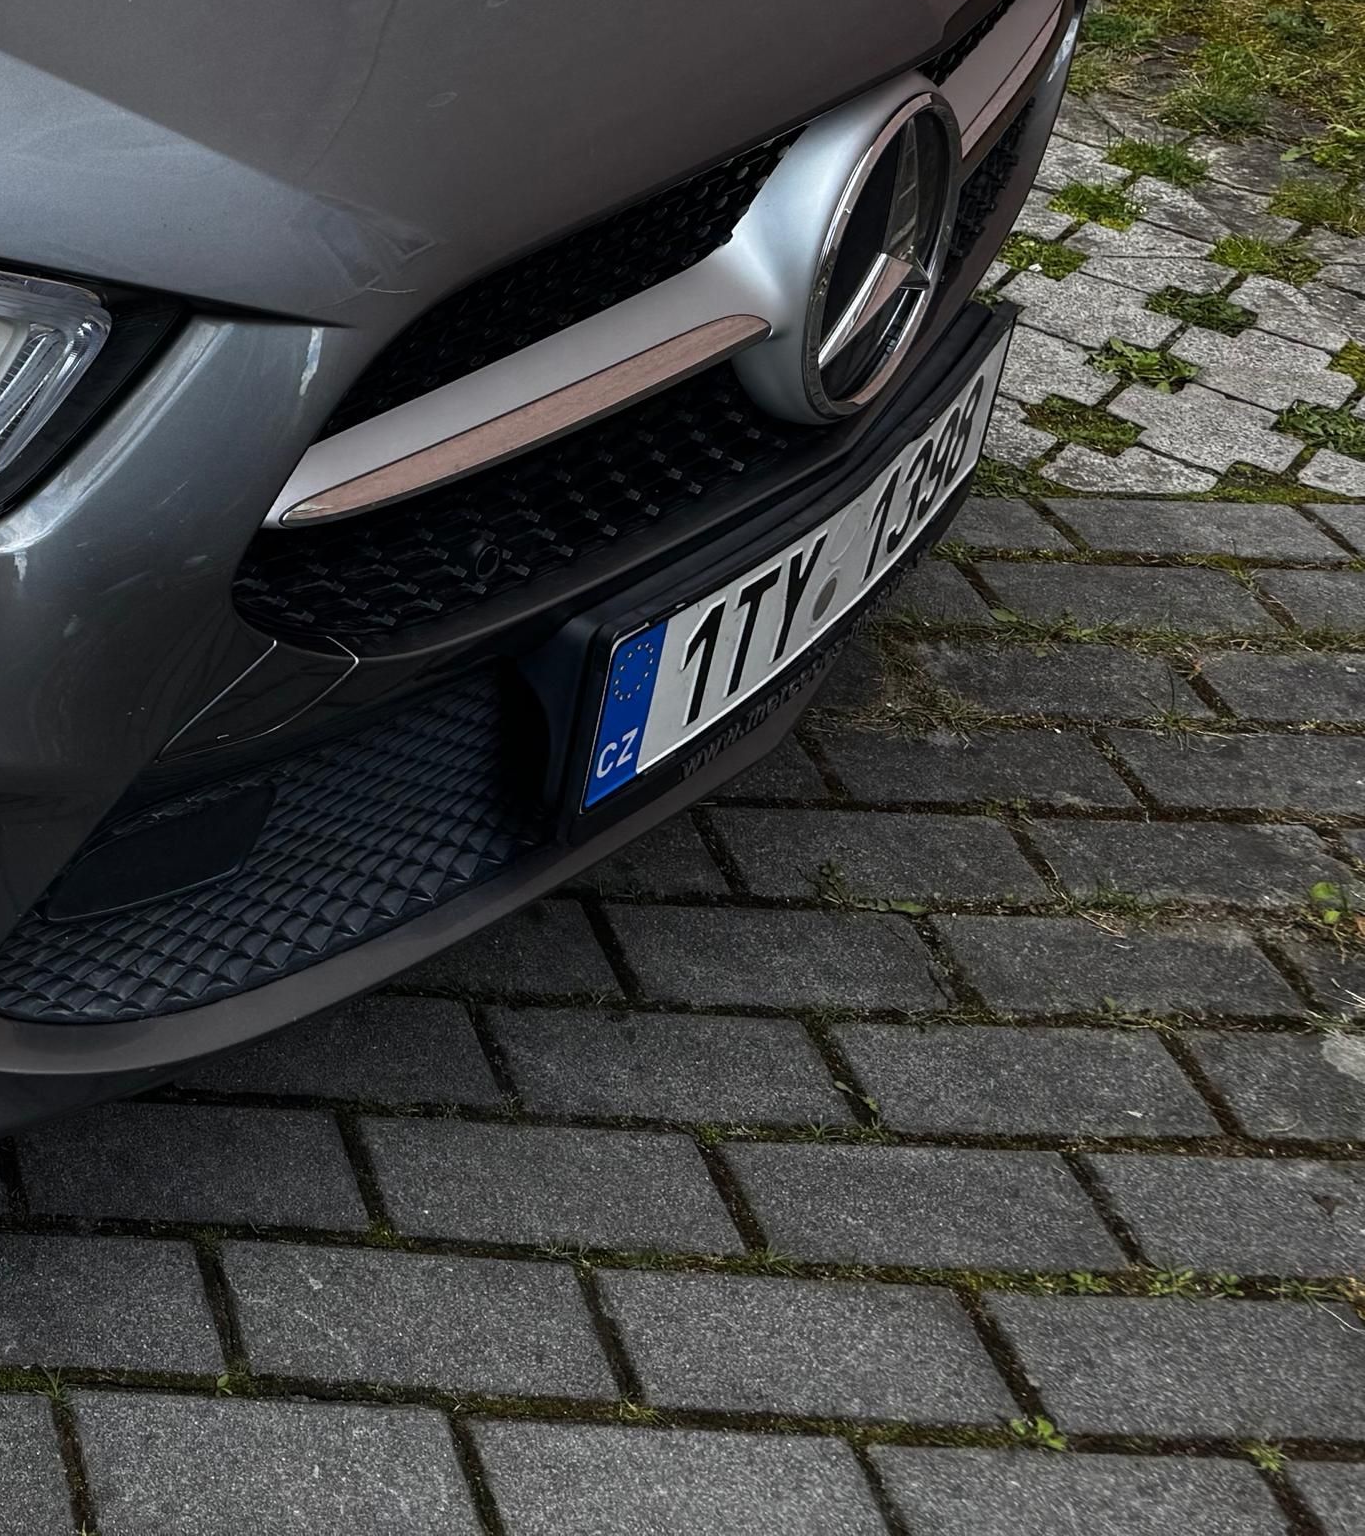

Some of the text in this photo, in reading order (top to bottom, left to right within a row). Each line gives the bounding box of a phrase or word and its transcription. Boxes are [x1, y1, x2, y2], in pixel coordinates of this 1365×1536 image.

[681, 374, 985, 726] 1TY 1398
[596, 727, 639, 779] CZ
